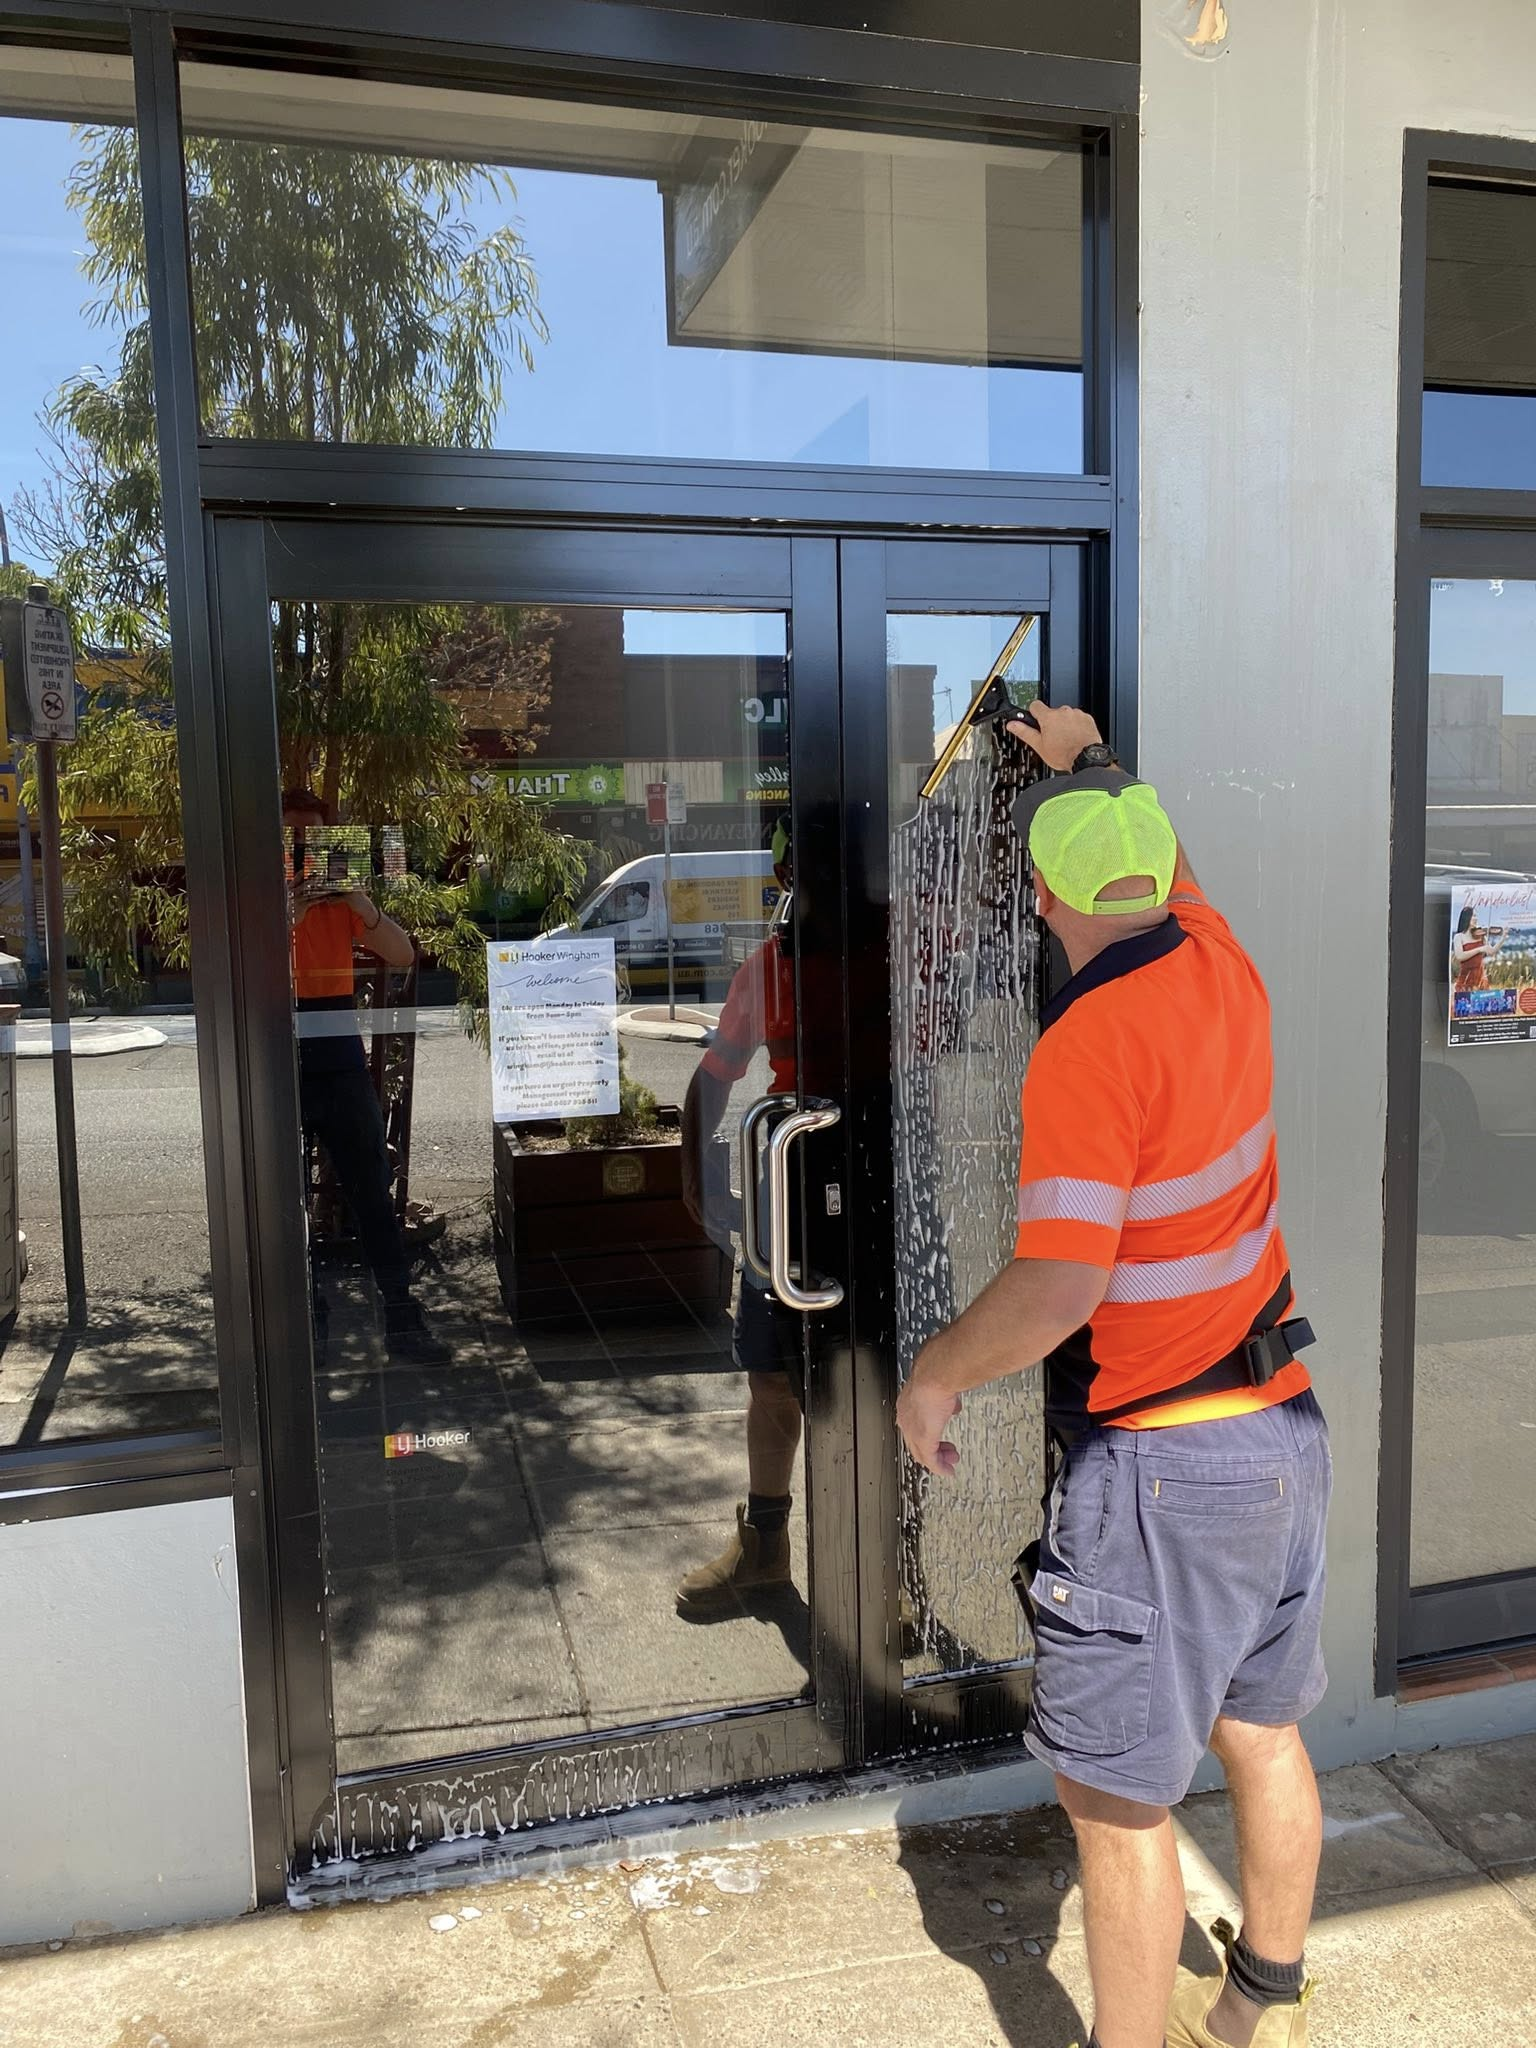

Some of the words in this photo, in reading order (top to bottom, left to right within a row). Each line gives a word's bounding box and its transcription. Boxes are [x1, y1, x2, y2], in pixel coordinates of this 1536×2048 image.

[522, 951, 556, 961] Hooker
[556, 950, 600, 961] Wingham
[578, 1078, 609, 1087] Property
[398, 1434, 410, 1454] LJ
[415, 1430, 470, 1449] Hooker
